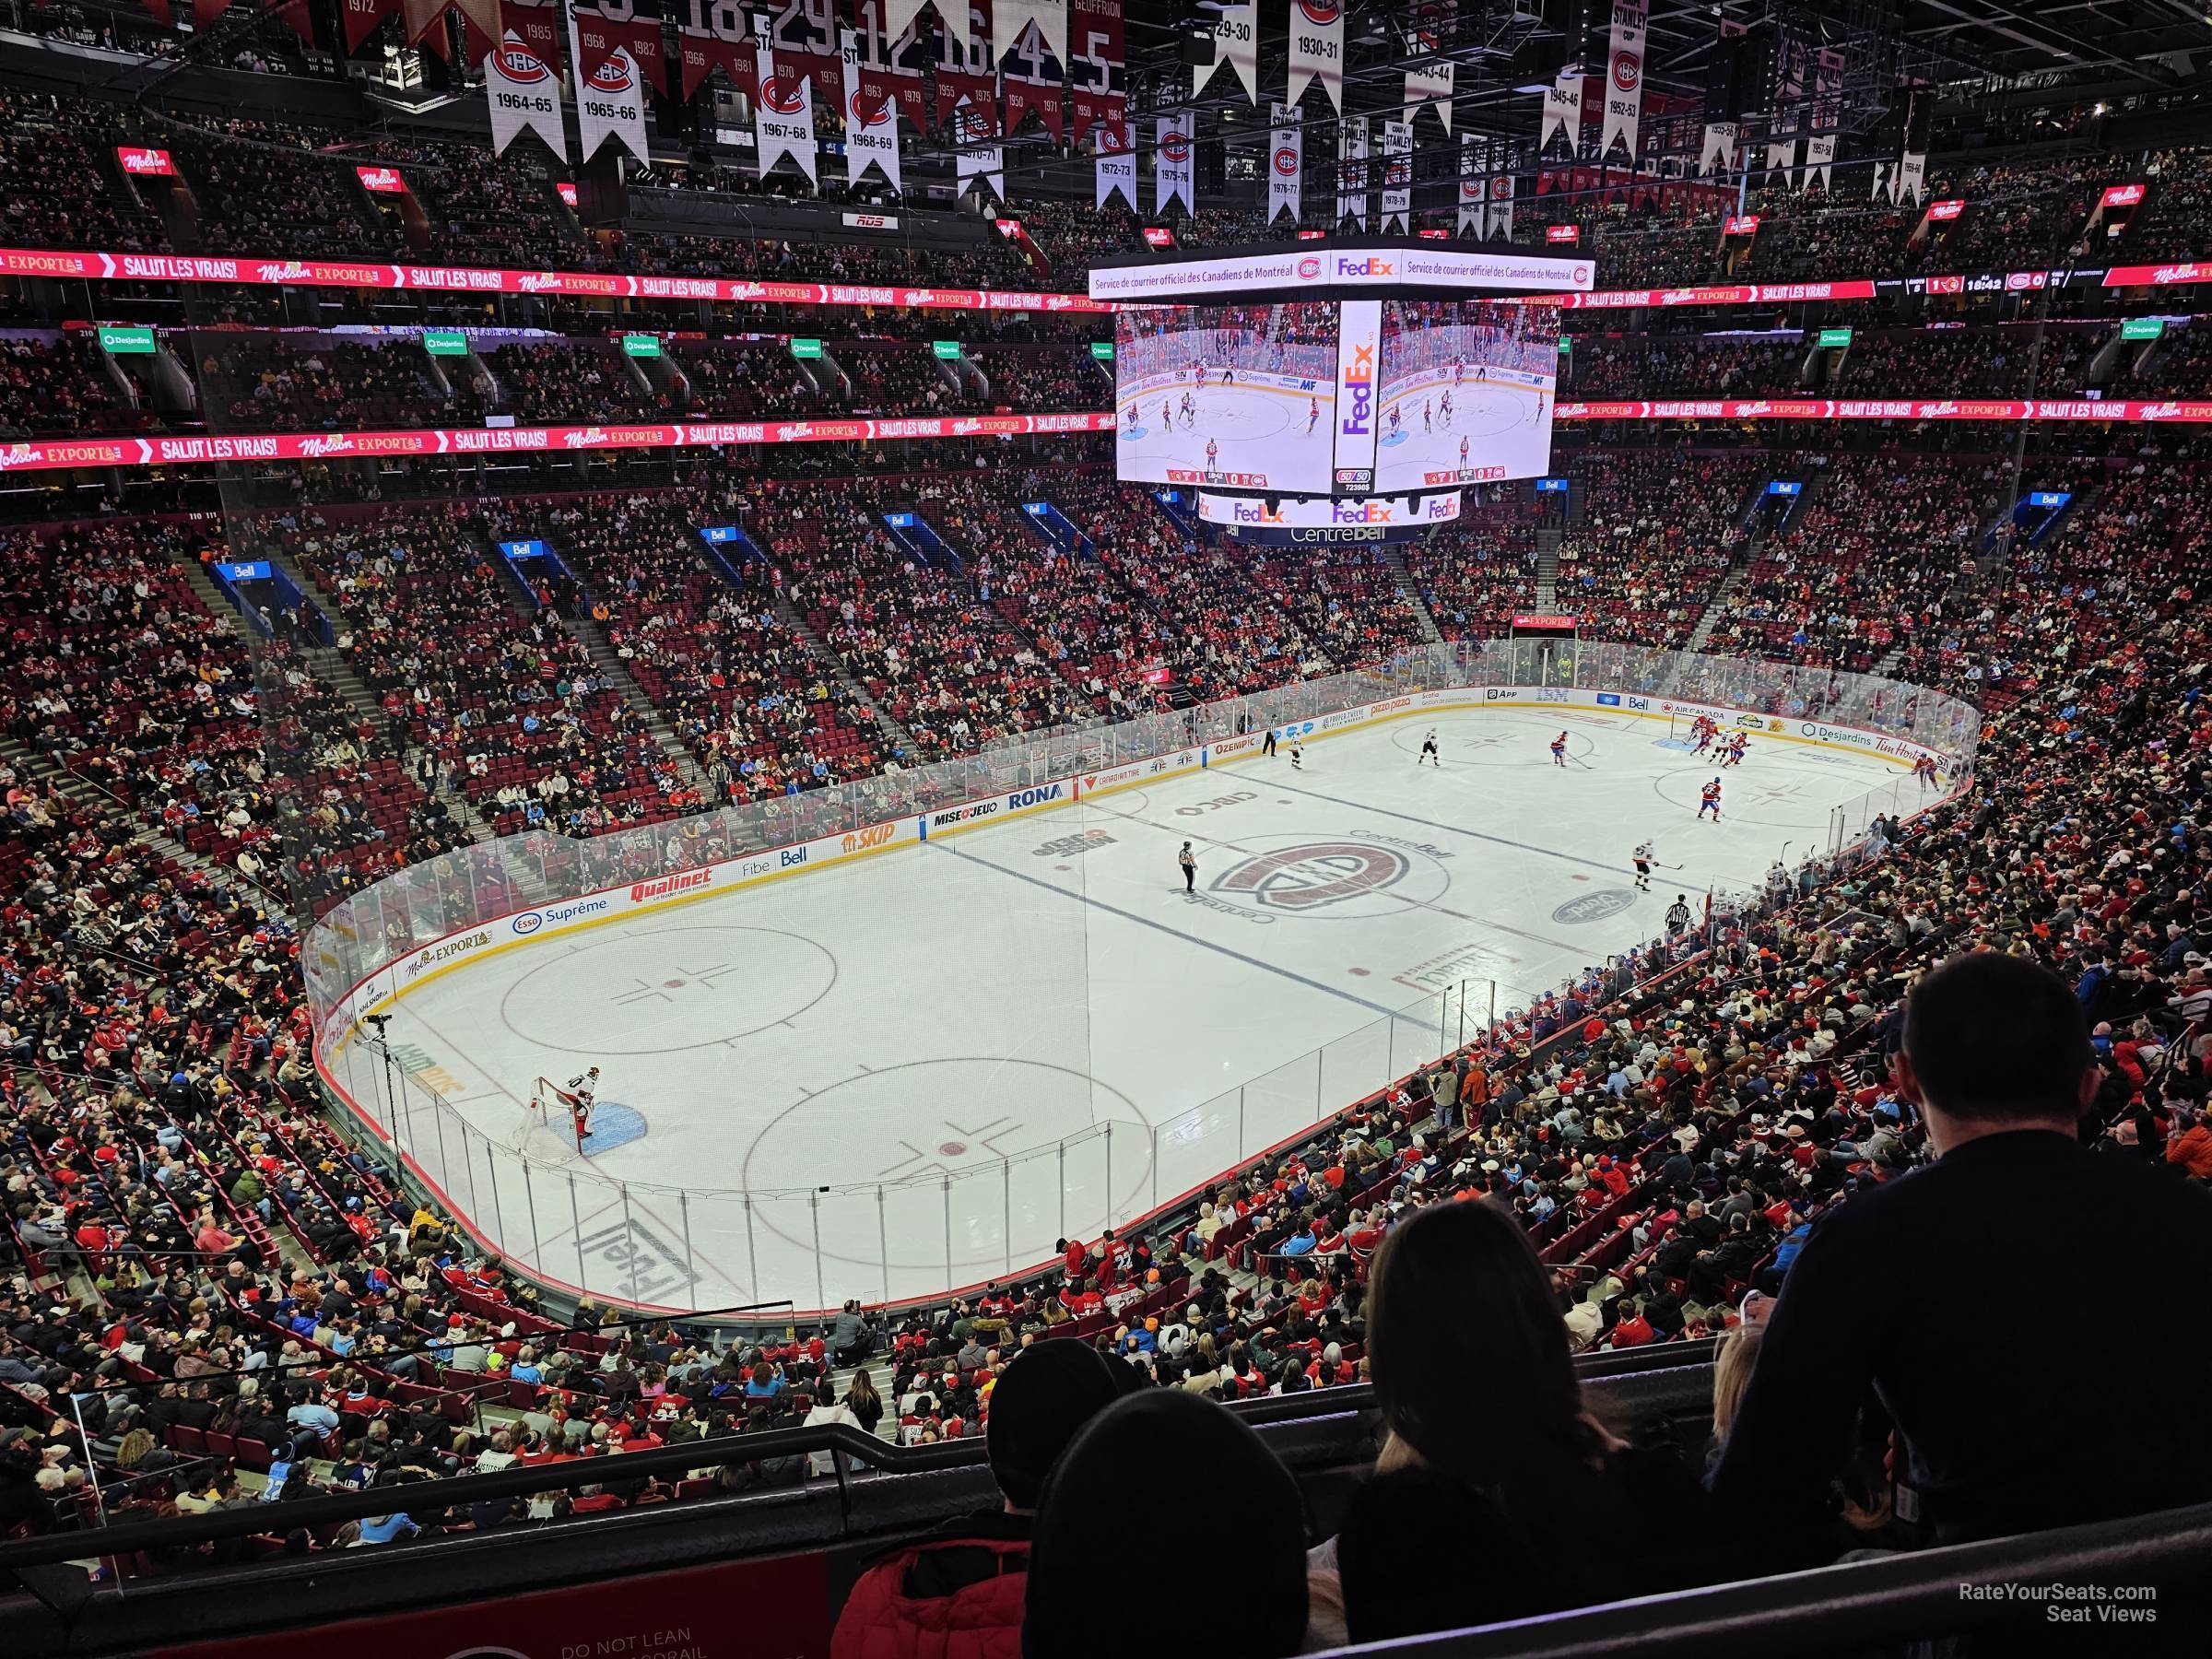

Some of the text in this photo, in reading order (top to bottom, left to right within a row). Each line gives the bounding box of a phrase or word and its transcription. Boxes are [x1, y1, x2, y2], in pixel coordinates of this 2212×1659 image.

[1614, 6, 1648, 30] STANLEY
[525, 23, 551, 41] 1985
[1623, 30, 1635, 41] CUP
[582, 33, 606, 49] 1968
[1298, 36, 1338, 59] 1930-31
[633, 41, 656, 57] 1982
[1018, 17, 1048, 88] 4
[684, 50, 705, 66] 1966
[733, 58, 752, 73] 1981
[1087, 30, 1110, 97] 5
[776, 64, 794, 79] 1970
[819, 70, 839, 85] 1979
[864, 84, 882, 98] 1963
[903, 90, 921, 103] 1979
[938, 84, 955, 98] 1955
[974, 89, 992, 103] 1975
[1549, 88, 1578, 107] 1945-46
[496, 93, 552, 112] 1964-65
[1008, 94, 1024, 108] 1950
[1043, 100, 1058, 113] 1971
[583, 101, 637, 121] 1965-66
[1077, 104, 1091, 117] 1950
[1107, 109, 1122, 121] 1964
[1609, 100, 1636, 118] 1952-53
[762, 123, 806, 139] 1967-68
[1392, 125, 1406, 135] COUPE
[853, 133, 892, 149] 1968-69
[1385, 134, 1411, 148] STANLEY
[124, 155, 166, 169] Molson
[1101, 163, 1130, 176] 1972-73
[361, 172, 396, 188] Molson
[1161, 170, 1189, 182] 1975-76
[1273, 183, 1298, 194] 1976-77
[1384, 195, 1406, 206] 1978-79
[2108, 190, 2140, 204] Molson
[124, 257, 238, 279] SALUT LES VRAIS!
[257, 264, 312, 284] Molson
[1338, 257, 1394, 276] FedEx
[1407, 261, 1571, 280] Service de courrier officiel des Canadiens de Montréal
[412, 269, 502, 288] SALUT LES VRAIS!
[518, 276, 562, 292] Molson
[1095, 264, 1292, 289] Service de courrier officiel des Canadiens de Montréal
[2153, 269, 2199, 284] Molson
[643, 280, 717, 296] SALUT LES VRAIS!
[730, 284, 766, 300] Molson
[1762, 283, 1830, 300] SALUT LES VRAIS!
[1967, 279, 2001, 291] 18:42
[832, 289, 894, 303] SALUT LES VRAIS!
[904, 293, 934, 306] Molson
[990, 295, 1041, 307] SALUT LES VRAIS!
[1585, 293, 1650, 306] SALUT LES VRAIS!
[1661, 290, 1695, 305] Molson
[115, 336, 150, 345] Desjardins
[158, 330, 170, 338] 211
[1343, 344, 1373, 435] FedEx
[1555, 404, 1588, 418] Molson
[1654, 402, 1723, 417] SALUT LES VRAIS!
[1735, 404, 1771, 417] Molson
[1840, 403, 1912, 417] SALUT LES VRAIS!
[1919, 404, 1958, 418] Molson
[2039, 404, 2125, 418] SALUT LES VRAIS!
[2139, 405, 2182, 420] Molson
[879, 420, 941, 435] SALUT LES VRAIS!
[952, 421, 982, 435] Molson
[1037, 416, 1088, 429] SALUT LES VRAIS!
[564, 430, 608, 447] Molson
[689, 425, 764, 442] SALUT LES VRAIS!
[777, 424, 813, 440] Molson
[297, 437, 354, 457] Molson
[455, 431, 547, 449] SALUT LES VRAIS!
[160, 437, 277, 459] SALUT LES VRAIS!
[1779, 484, 1792, 492] Bell
[2041, 495, 2058, 505] Bell
[1332, 502, 1392, 524] FedEx
[1429, 497, 1456, 519] FedEx
[189, 512, 202, 521] 110
[206, 512, 218, 520] 111
[892, 516, 904, 525] Bell
[712, 530, 726, 540] Bell
[513, 544, 531, 555] Bell
[234, 565, 255, 578] Bell
[1371, 700, 1390, 716] pizza
[1390, 698, 1411, 712] pizza
[1629, 698, 1649, 711] Bell
[1675, 705, 1690, 714] AIR
[1818, 726, 1872, 746] Desjardins
[1876, 736, 1894, 755] Tim
[1099, 768, 1140, 785] CANADIAN TIRE
[1009, 783, 1063, 810] RONA
[1207, 791, 1260, 809] CIBC
[855, 823, 895, 851] SKIP
[742, 847, 807, 877] Fibe Bell
[630, 867, 712, 903] Qualinet
[546, 900, 607, 923] Suprême
[406, 933, 481, 978] Molson EXPORT
[561, 1627, 690, 1659] DO NOT LEAN
